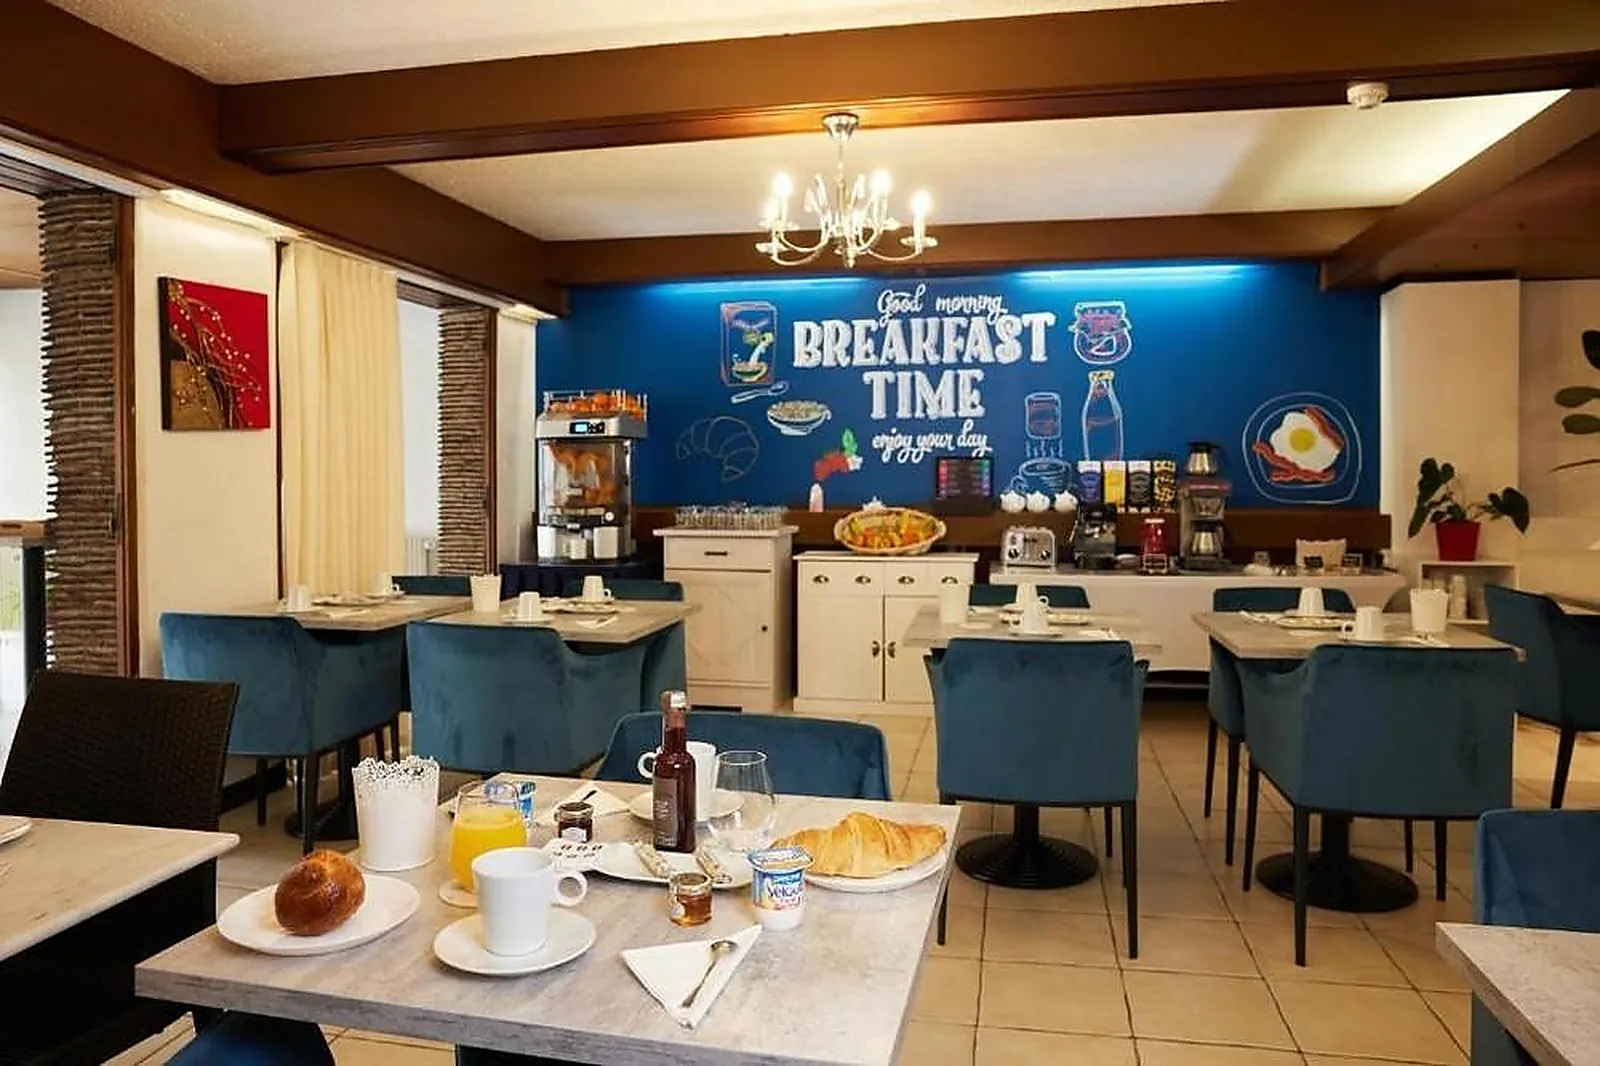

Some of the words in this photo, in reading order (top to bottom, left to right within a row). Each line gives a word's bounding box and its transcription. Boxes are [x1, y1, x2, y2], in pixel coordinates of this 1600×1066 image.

[877, 283, 926, 328] Good
[935, 294, 1008, 326] morning
[793, 312, 1057, 368] BREAKFAST
[862, 369, 986, 420] TIME
[872, 427, 913, 463] enjoy
[911, 433, 956, 463] your
[957, 418, 993, 457] day
